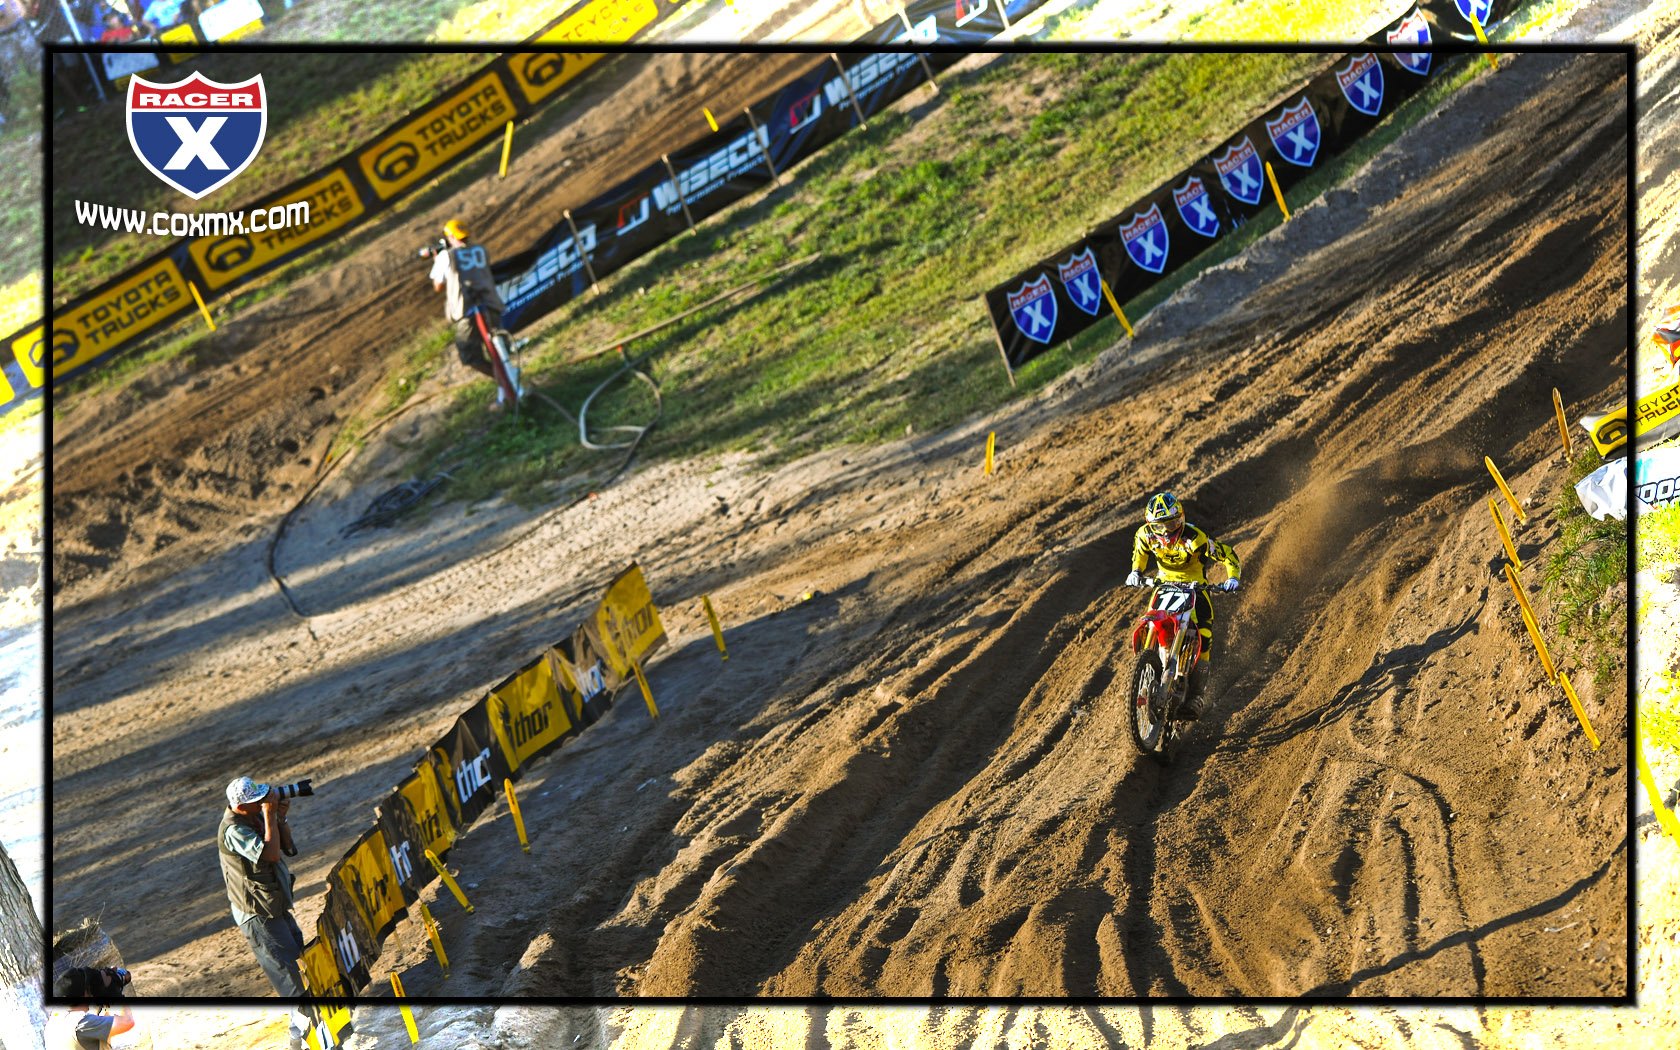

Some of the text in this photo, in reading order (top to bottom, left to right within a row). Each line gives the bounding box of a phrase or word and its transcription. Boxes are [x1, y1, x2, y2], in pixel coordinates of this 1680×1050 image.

[1342, 56, 1376, 86] RACER
[1354, 72, 1380, 109] X
[416, 84, 498, 141] TOYOTA
[424, 99, 507, 157] TRUCKS
[1273, 108, 1311, 134] RACER
[1286, 123, 1316, 160] X
[652, 123, 770, 211] WISECO
[1220, 148, 1253, 175] RACER
[1232, 161, 1260, 197] X
[1125, 214, 1161, 240] RACER
[1190, 193, 1217, 229] X
[1136, 229, 1164, 265] X
[1063, 258, 1092, 278] RACER
[77, 269, 173, 329] TOYOTA
[1012, 285, 1049, 308] RACER
[1074, 273, 1097, 306] X
[84, 285, 182, 346] TRUCKS
[1022, 298, 1051, 335] X
[1157, 591, 1190, 611] 17
[514, 702, 553, 747] thor
